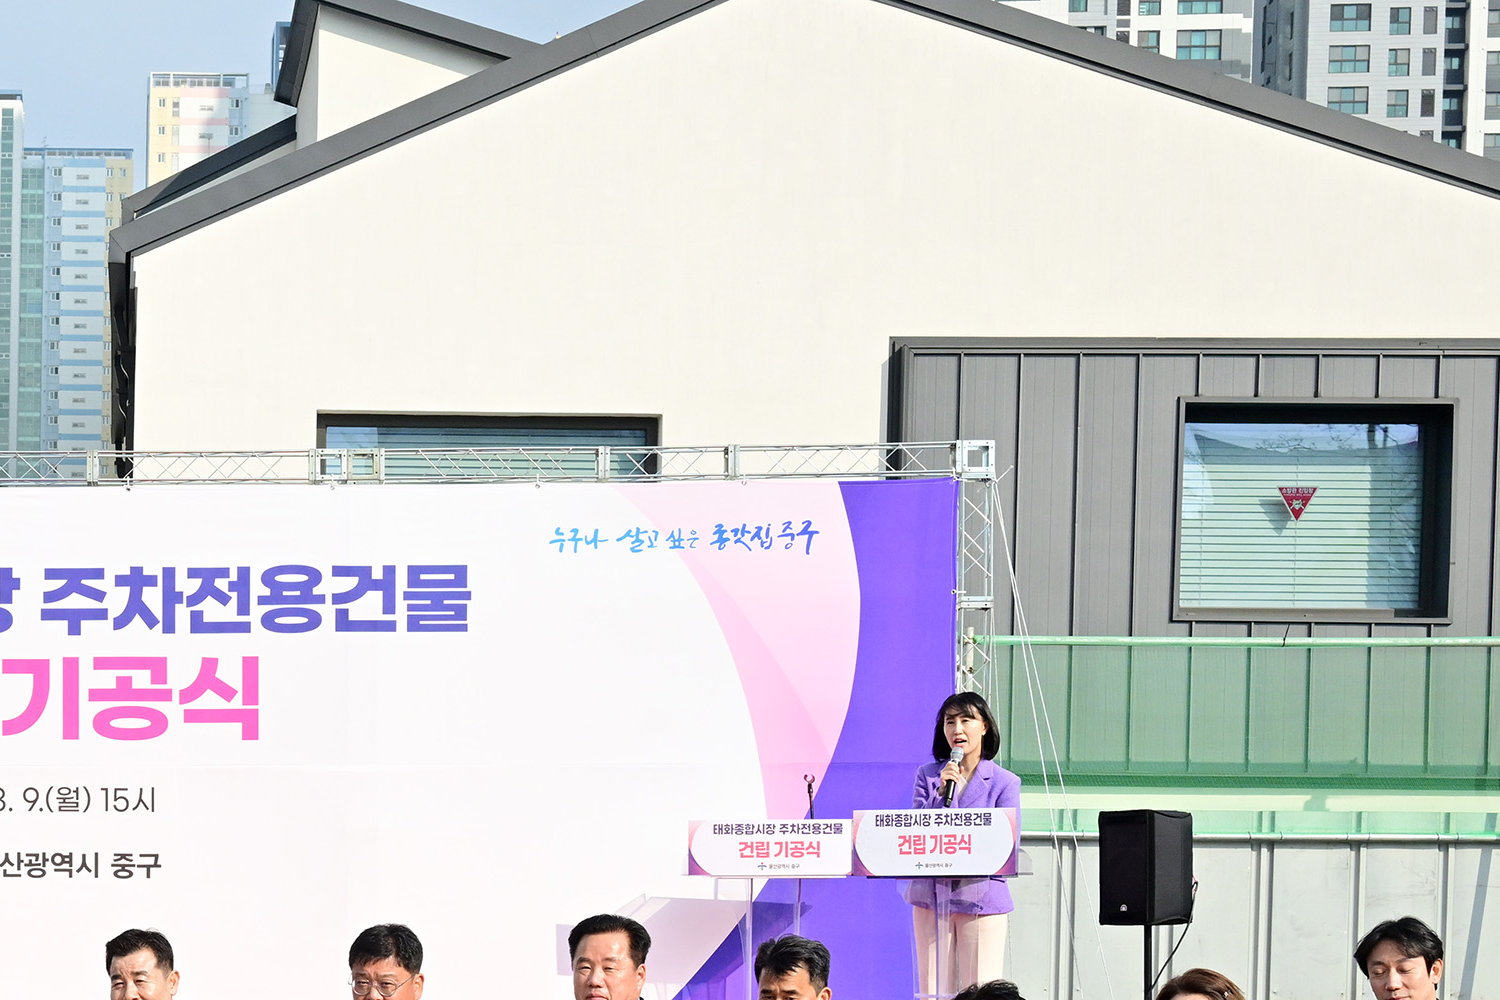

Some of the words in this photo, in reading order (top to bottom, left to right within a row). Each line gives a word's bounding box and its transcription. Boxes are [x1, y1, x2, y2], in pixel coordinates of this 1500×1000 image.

[549, 526, 609, 553] 누구나
[616, 526, 659, 553] 살고
[665, 528, 699, 550] 싶은
[709, 523, 773, 552] 종갓집
[777, 520, 820, 555] 중구
[41, 565, 472, 635] 주차전용건물
[1, 655, 259, 741] 기공식
[22, 786, 91, 813] 9.(월)
[100, 786, 155, 813] 15시
[713, 823, 776, 835] 태화종합시장
[779, 823, 843, 835] 주차전용건물
[875, 813, 932, 828] 태화종합시장
[934, 812, 992, 827] 주차전용건물
[738, 841, 770, 858] 건립
[774, 841, 821, 858] 기공식
[898, 834, 926, 855] 건립
[929, 833, 972, 855] 기공식
[110, 853, 162, 880] 중구
